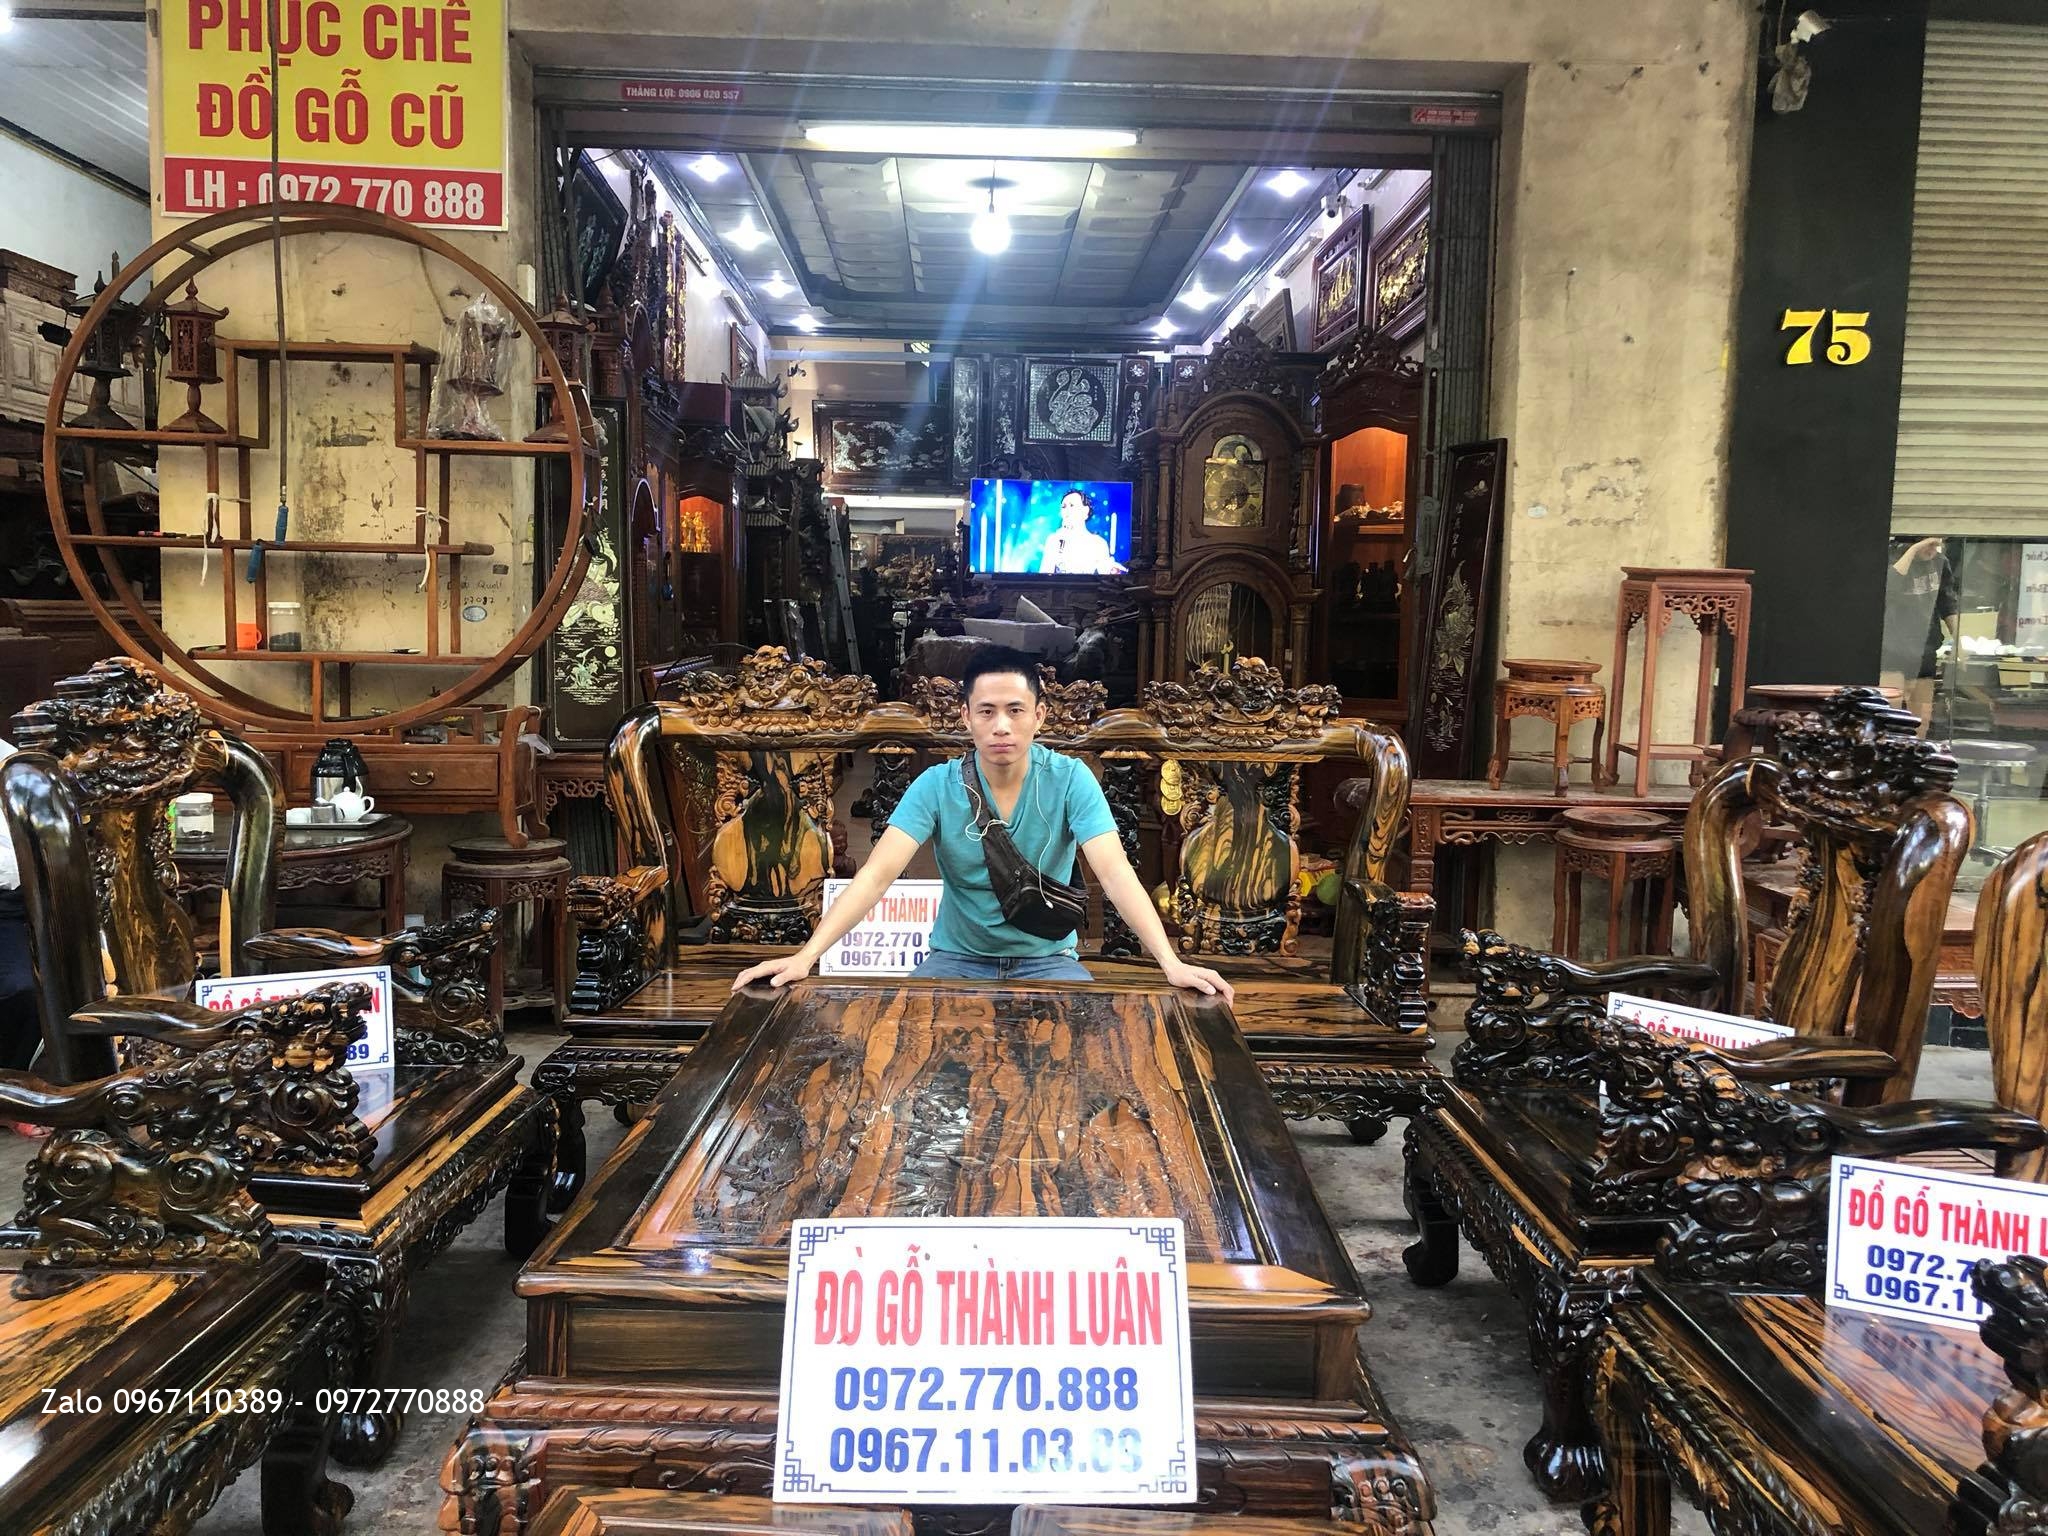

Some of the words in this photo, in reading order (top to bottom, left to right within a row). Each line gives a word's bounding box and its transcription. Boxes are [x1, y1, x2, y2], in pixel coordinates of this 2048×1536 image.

[188, 0, 341, 66] PHỤC
[196, 66, 273, 140] ĐỒ
[295, 68, 369, 145] GỖ
[391, 84, 465, 149] CŨ
[184, 169, 226, 208] LH
[351, 178, 413, 217] 770
[424, 181, 485, 220] 888
[1780, 308, 1871, 366] 75
[880, 892, 928, 922] THÀNH
[1849, 1179, 1884, 1230] ĐỒ
[1894, 1186, 1930, 1238] GỖ
[1939, 1200, 2030, 1254] THÀNH
[876, 1243, 923, 1346] GỖ
[936, 1257, 1055, 1346] THÀNH
[1068, 1256, 1163, 1346] LUÂN
[835, 1366, 1139, 1412] 0972.770.888
